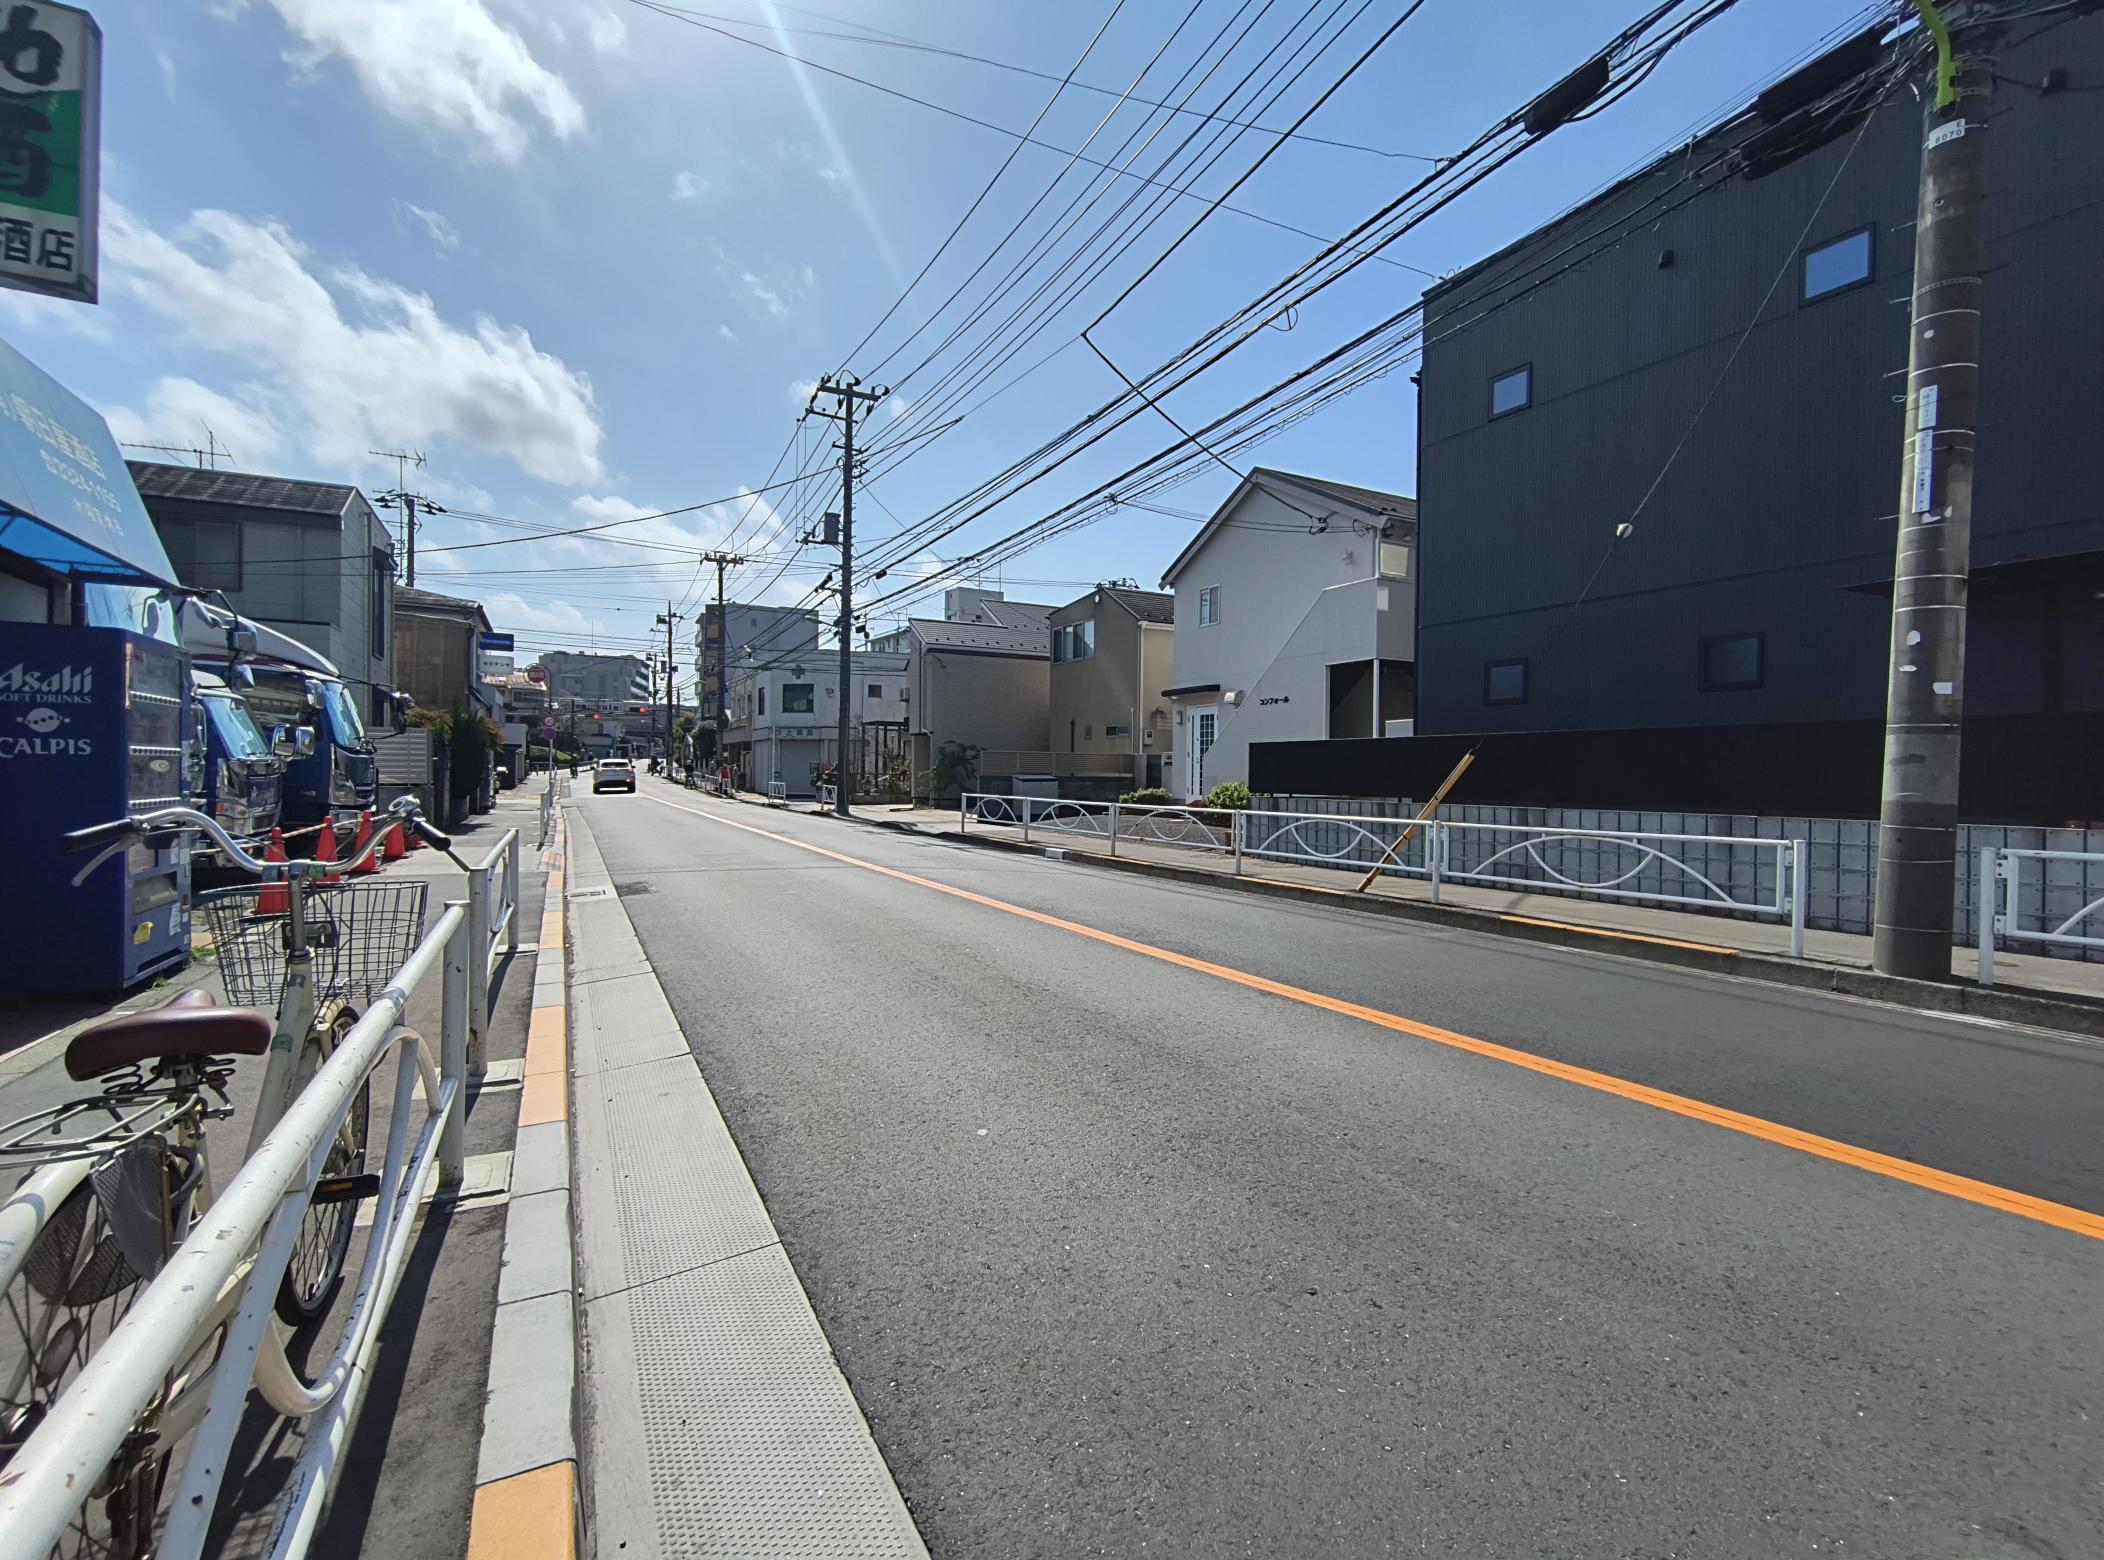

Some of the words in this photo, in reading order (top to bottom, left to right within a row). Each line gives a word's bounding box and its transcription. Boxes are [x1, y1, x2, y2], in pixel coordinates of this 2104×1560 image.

[0, 662, 92, 694] Asahi
[0, 692, 32, 702] OFT
[36, 693, 92, 704] DRINKS
[1259, 695, 1290, 706] コンフォール
